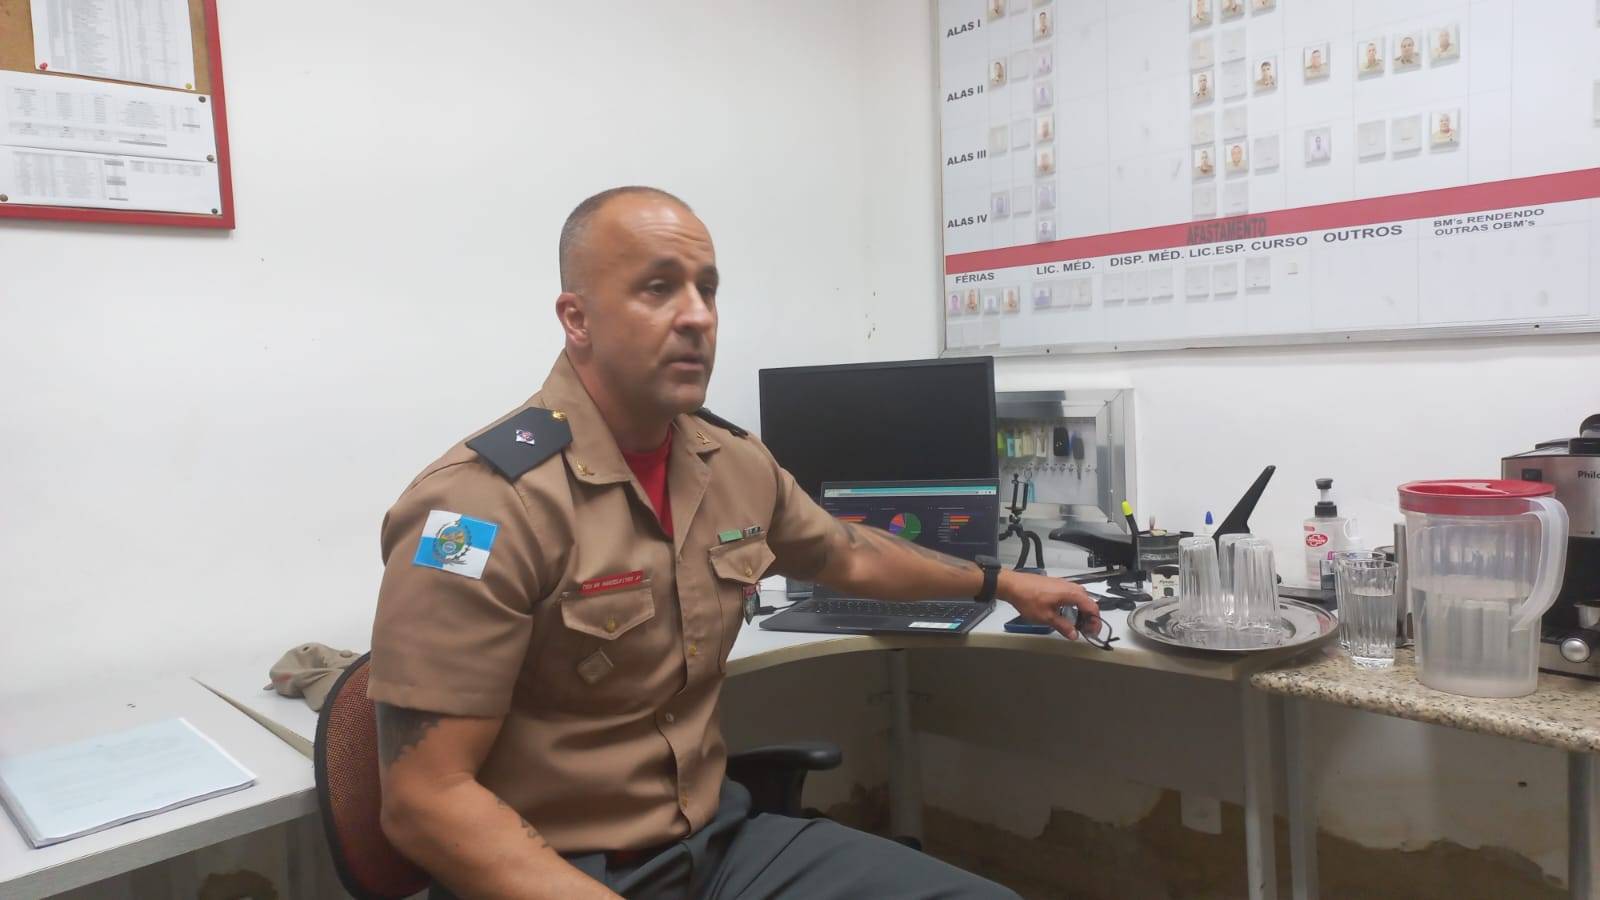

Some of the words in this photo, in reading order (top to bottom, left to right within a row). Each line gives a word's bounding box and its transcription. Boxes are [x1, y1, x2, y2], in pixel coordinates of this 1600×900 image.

[947, 21, 974, 38] ALAS
[947, 88, 974, 102] ALAS
[977, 84, 984, 94] II
[947, 152, 974, 166] ALAS
[977, 149, 987, 159] III
[947, 216, 974, 228] ALAS
[977, 214, 988, 223] IV
[1433, 218, 1463, 228] BM's
[1467, 208, 1545, 224] RENDENDO
[1187, 217, 1267, 246] AFASTAMENTO
[1323, 224, 1403, 243] OUTROS
[1434, 224, 1489, 236] OUTRAS
[1492, 219, 1536, 230] OBM's
[1251, 236, 1308, 251] CURSO
[1110, 255, 1144, 267] DISP.
[1148, 249, 1185, 263] MÉD.
[1036, 264, 1060, 275] LIC.
[1063, 259, 1095, 272] MÉD.
[955, 272, 995, 284] FÉRIAS
